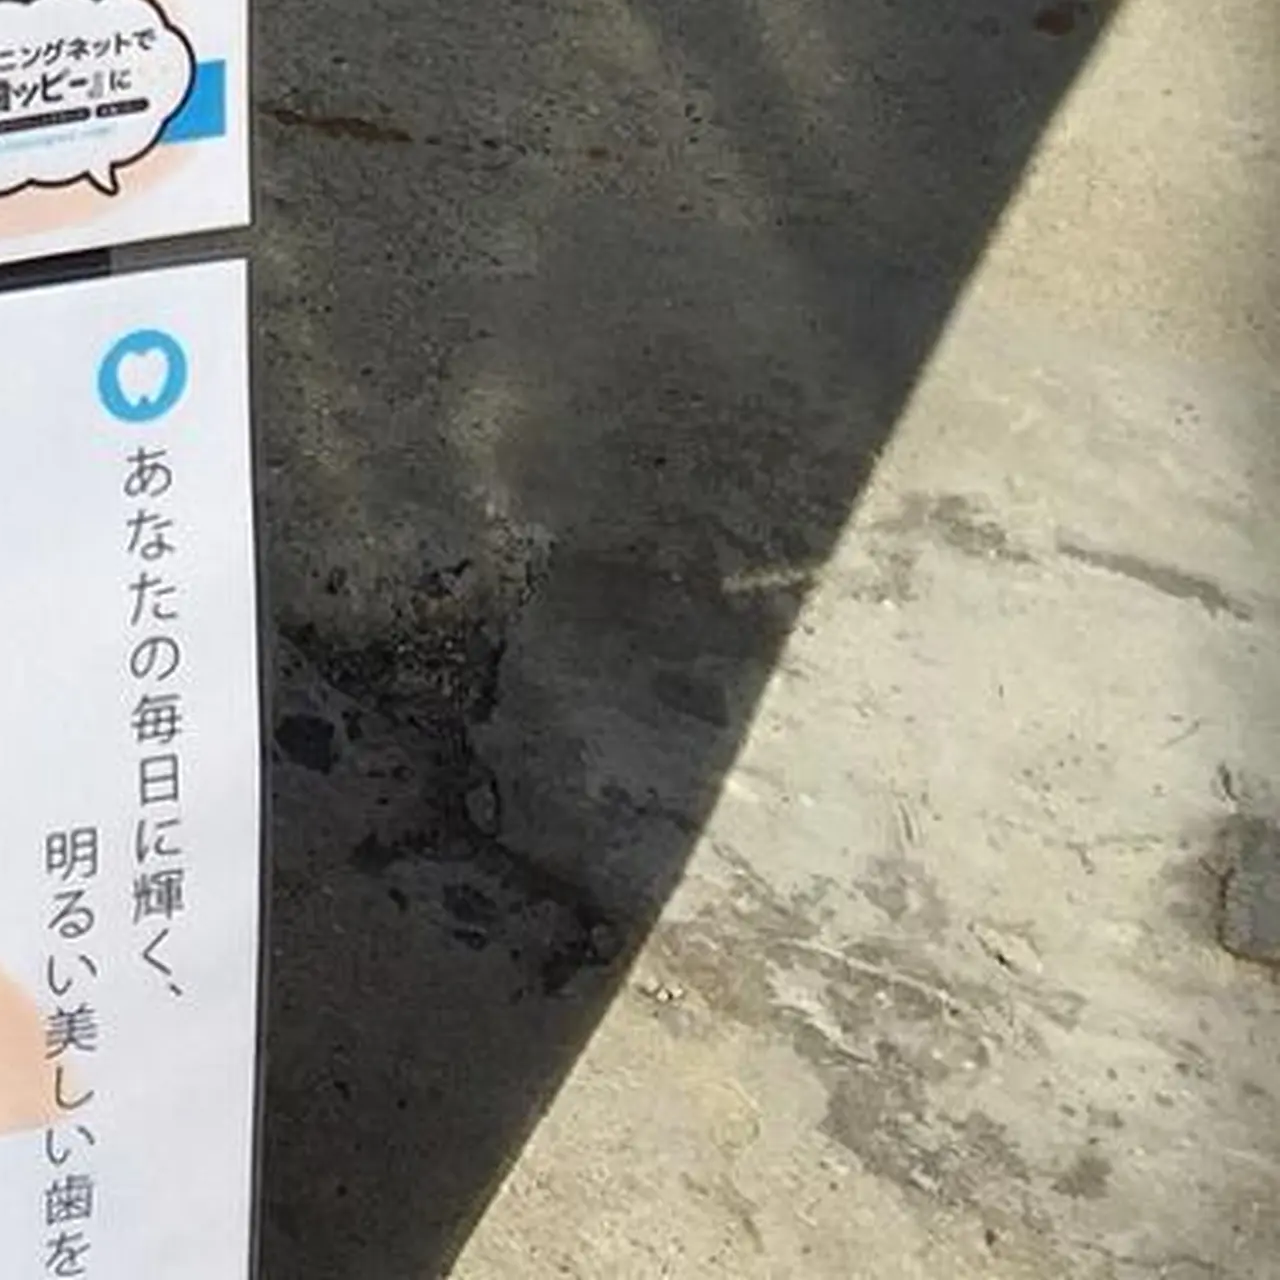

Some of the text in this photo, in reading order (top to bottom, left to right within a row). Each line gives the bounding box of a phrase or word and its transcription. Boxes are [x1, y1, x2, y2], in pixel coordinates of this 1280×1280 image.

[121, 446, 184, 998] あなたの毎日に輝く、
